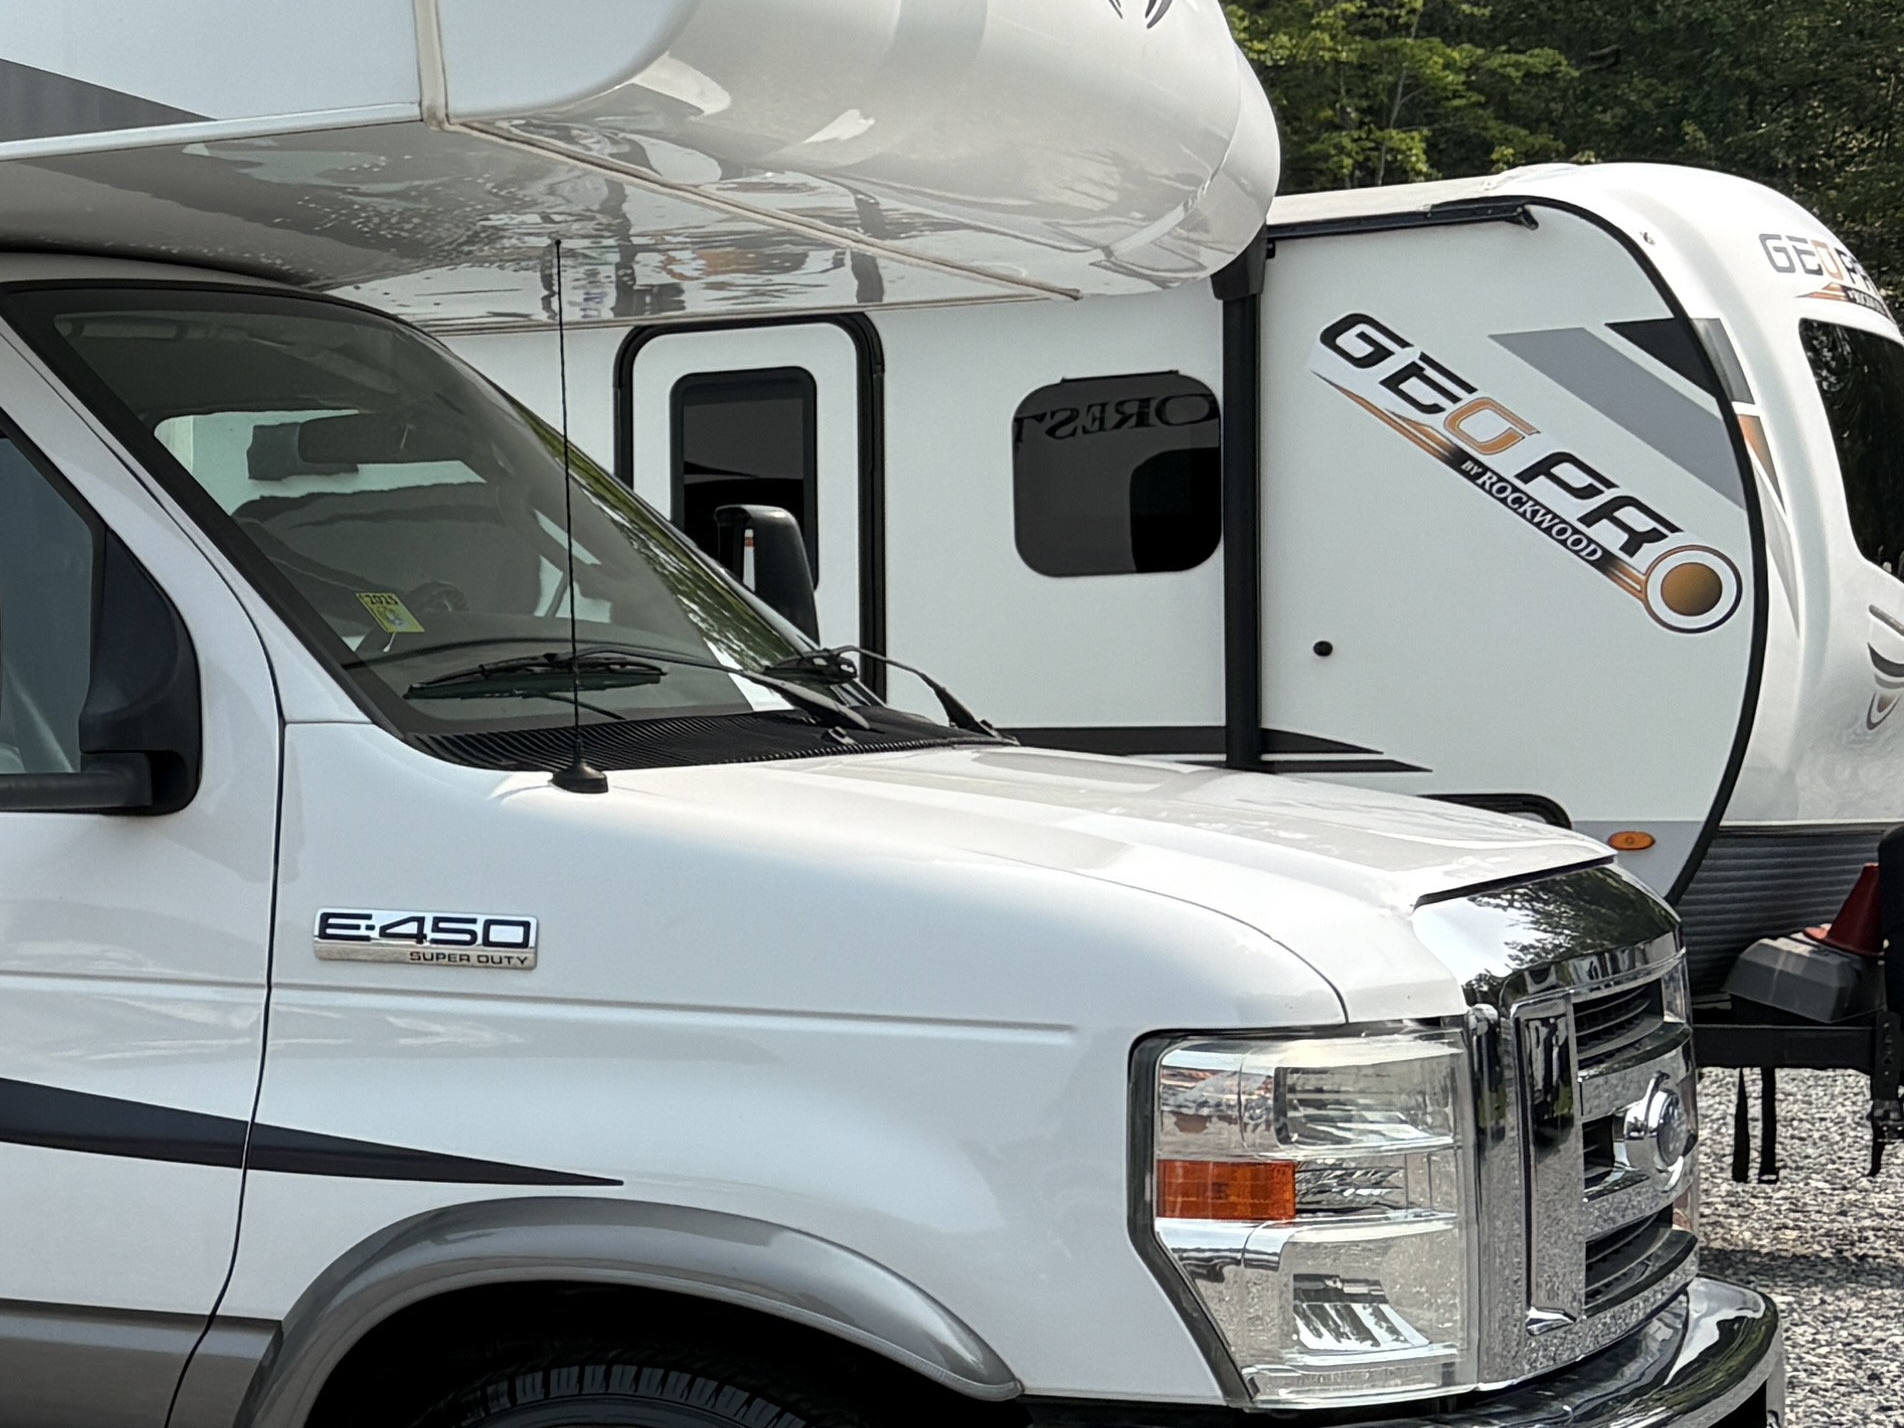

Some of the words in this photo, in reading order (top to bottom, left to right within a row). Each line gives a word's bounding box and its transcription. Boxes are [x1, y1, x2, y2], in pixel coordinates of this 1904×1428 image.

[1759, 233, 1844, 281] GEO
[1319, 313, 1542, 455] GEO
[1461, 459, 1482, 477] BY
[1477, 465, 1604, 564] ROCKWOOD
[409, 951, 471, 964] SUPER
[477, 954, 529, 966] DUTY
